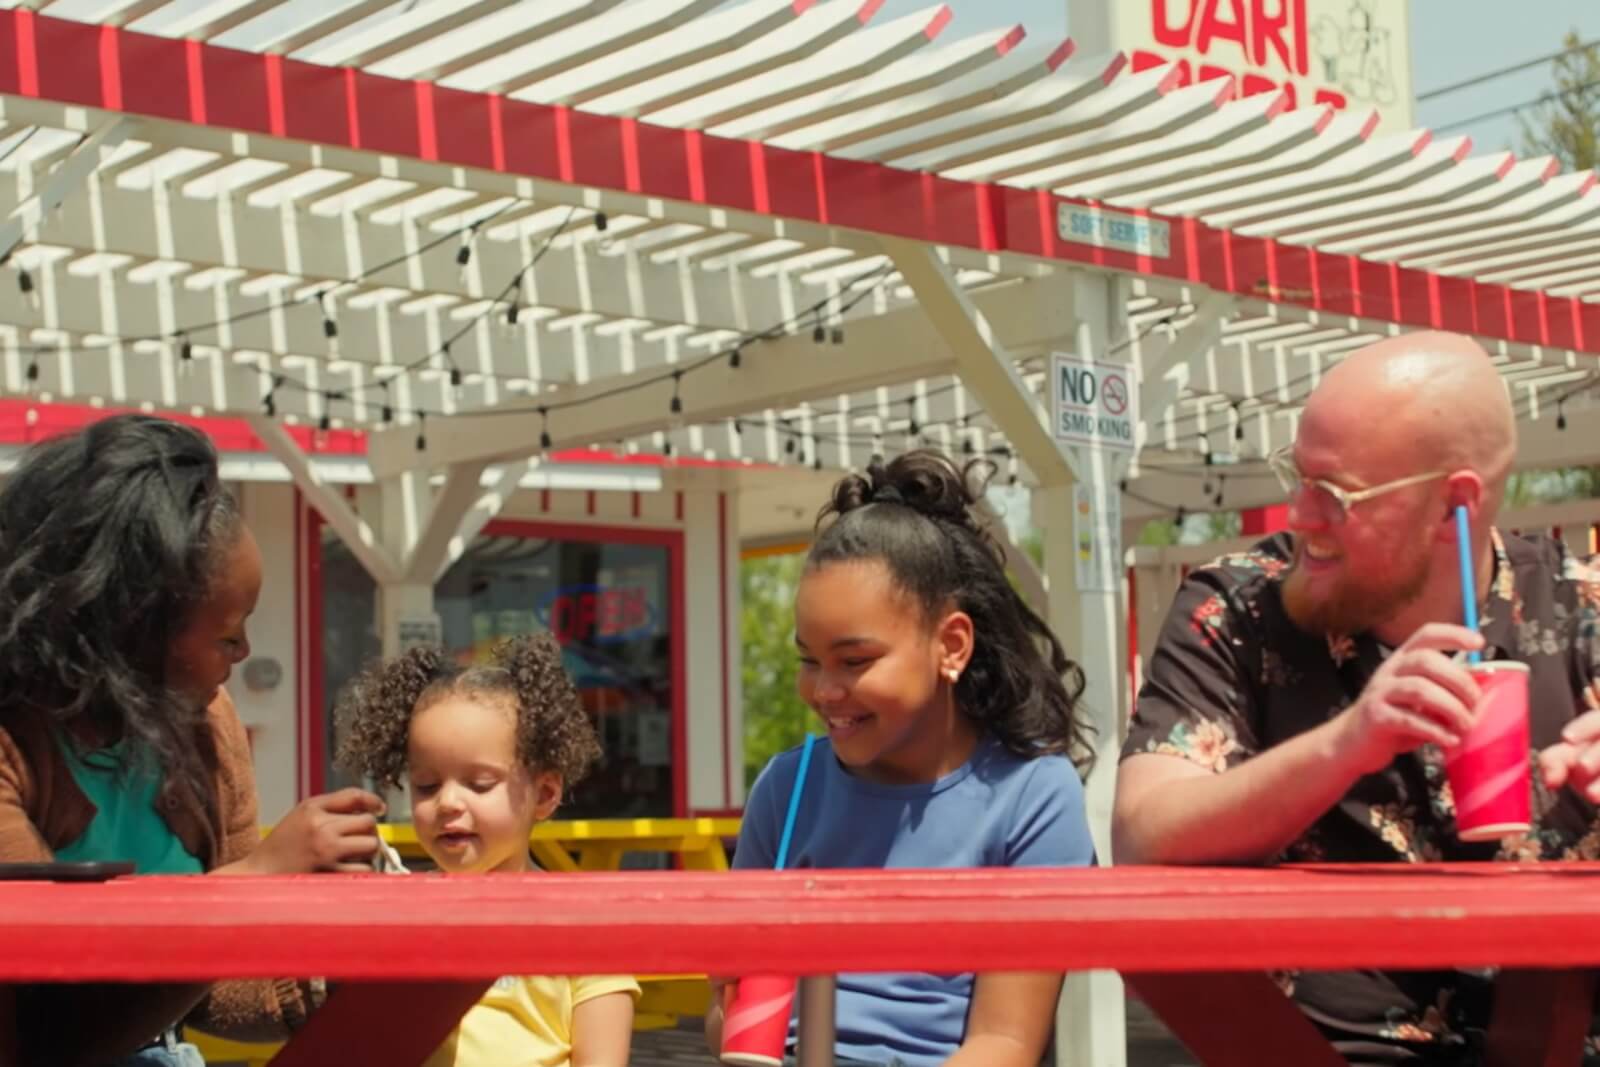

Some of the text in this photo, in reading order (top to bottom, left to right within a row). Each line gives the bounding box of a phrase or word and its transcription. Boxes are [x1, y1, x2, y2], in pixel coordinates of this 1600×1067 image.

[1061, 366, 1096, 405] NO
[1061, 411, 1131, 440] SMOKING
[550, 586, 645, 646] OPEN
